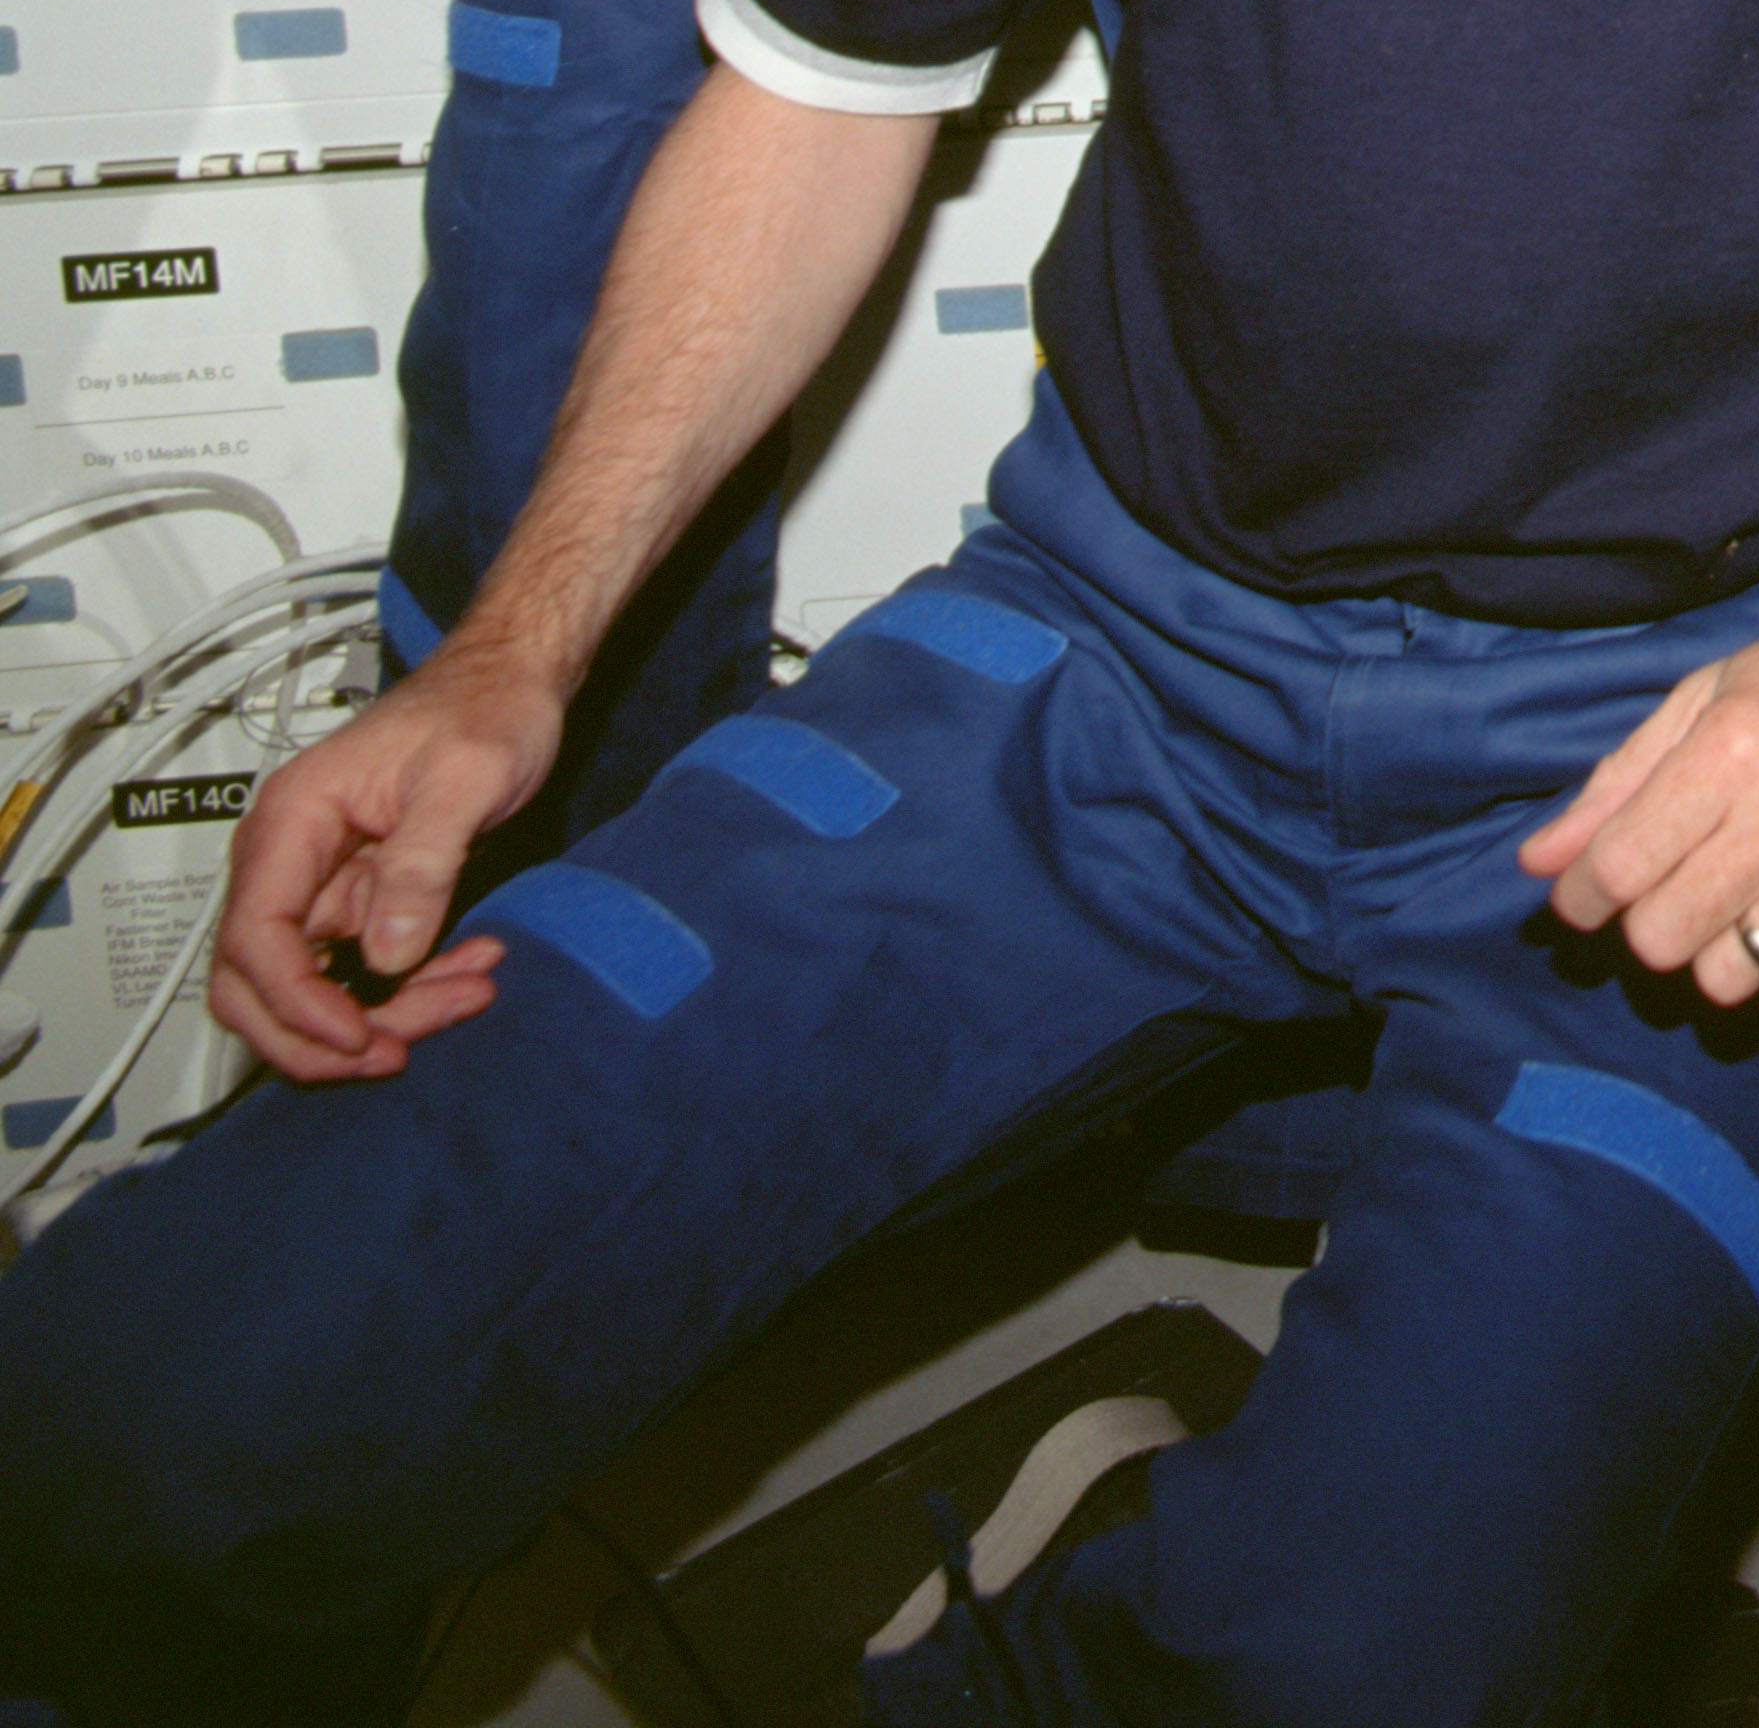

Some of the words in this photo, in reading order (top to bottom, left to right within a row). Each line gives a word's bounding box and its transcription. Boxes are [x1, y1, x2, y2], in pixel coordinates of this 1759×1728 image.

[74, 256, 207, 293] MF14M
[77, 375, 112, 392] Day
[116, 373, 128, 388] 9
[132, 370, 183, 386] Meals
[82, 452, 116, 469] Day
[123, 449, 143, 464] 10
[147, 445, 197, 461] Meals
[125, 877, 181, 891] Sample
